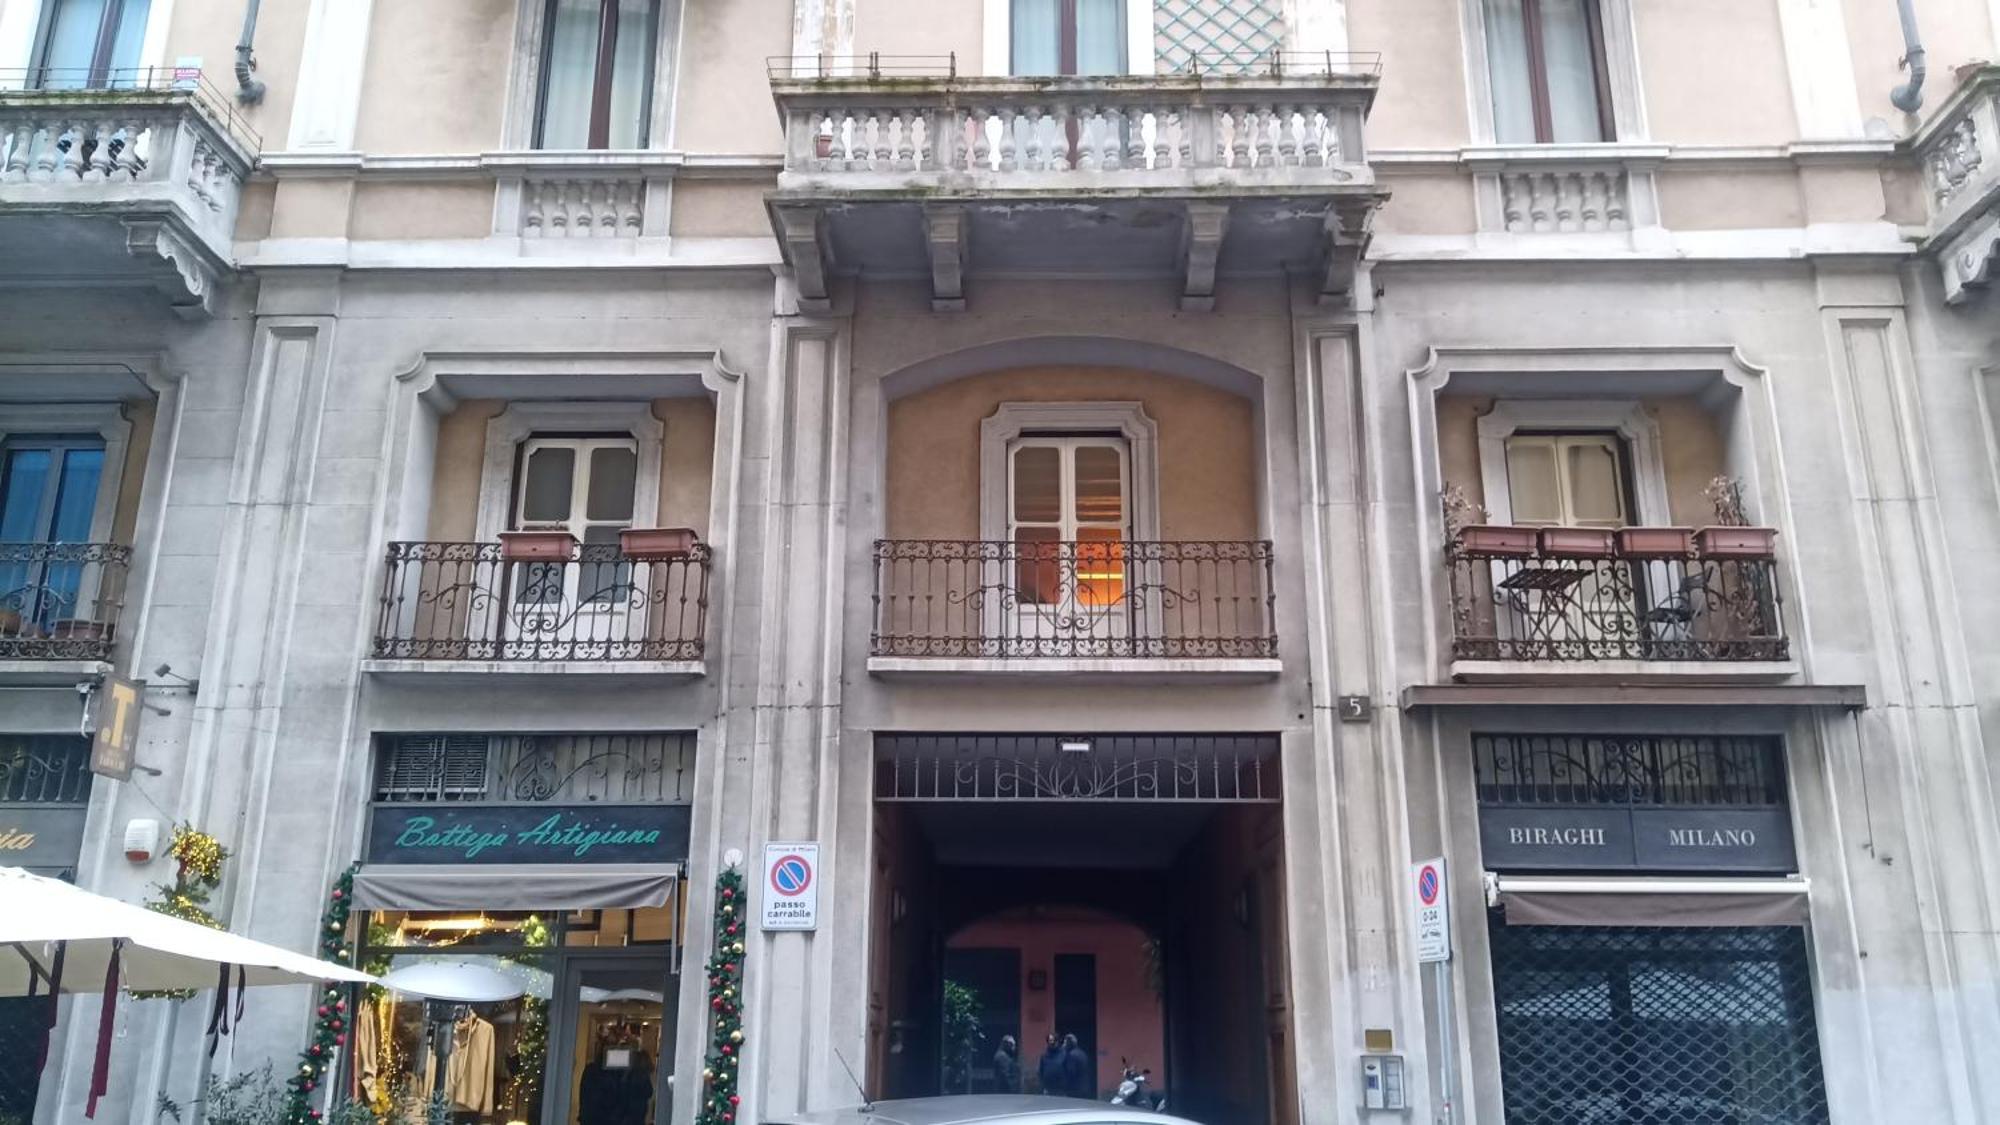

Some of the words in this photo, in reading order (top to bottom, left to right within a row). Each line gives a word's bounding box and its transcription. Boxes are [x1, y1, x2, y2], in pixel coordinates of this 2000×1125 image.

[1350, 698, 1361, 716] 5
[517, 813, 660, 856] Artigiana
[1509, 827, 1606, 845] BIRAGHI
[1669, 829, 1756, 846] MILANO
[767, 909, 811, 918] carrabile
[774, 901, 806, 909] passo
